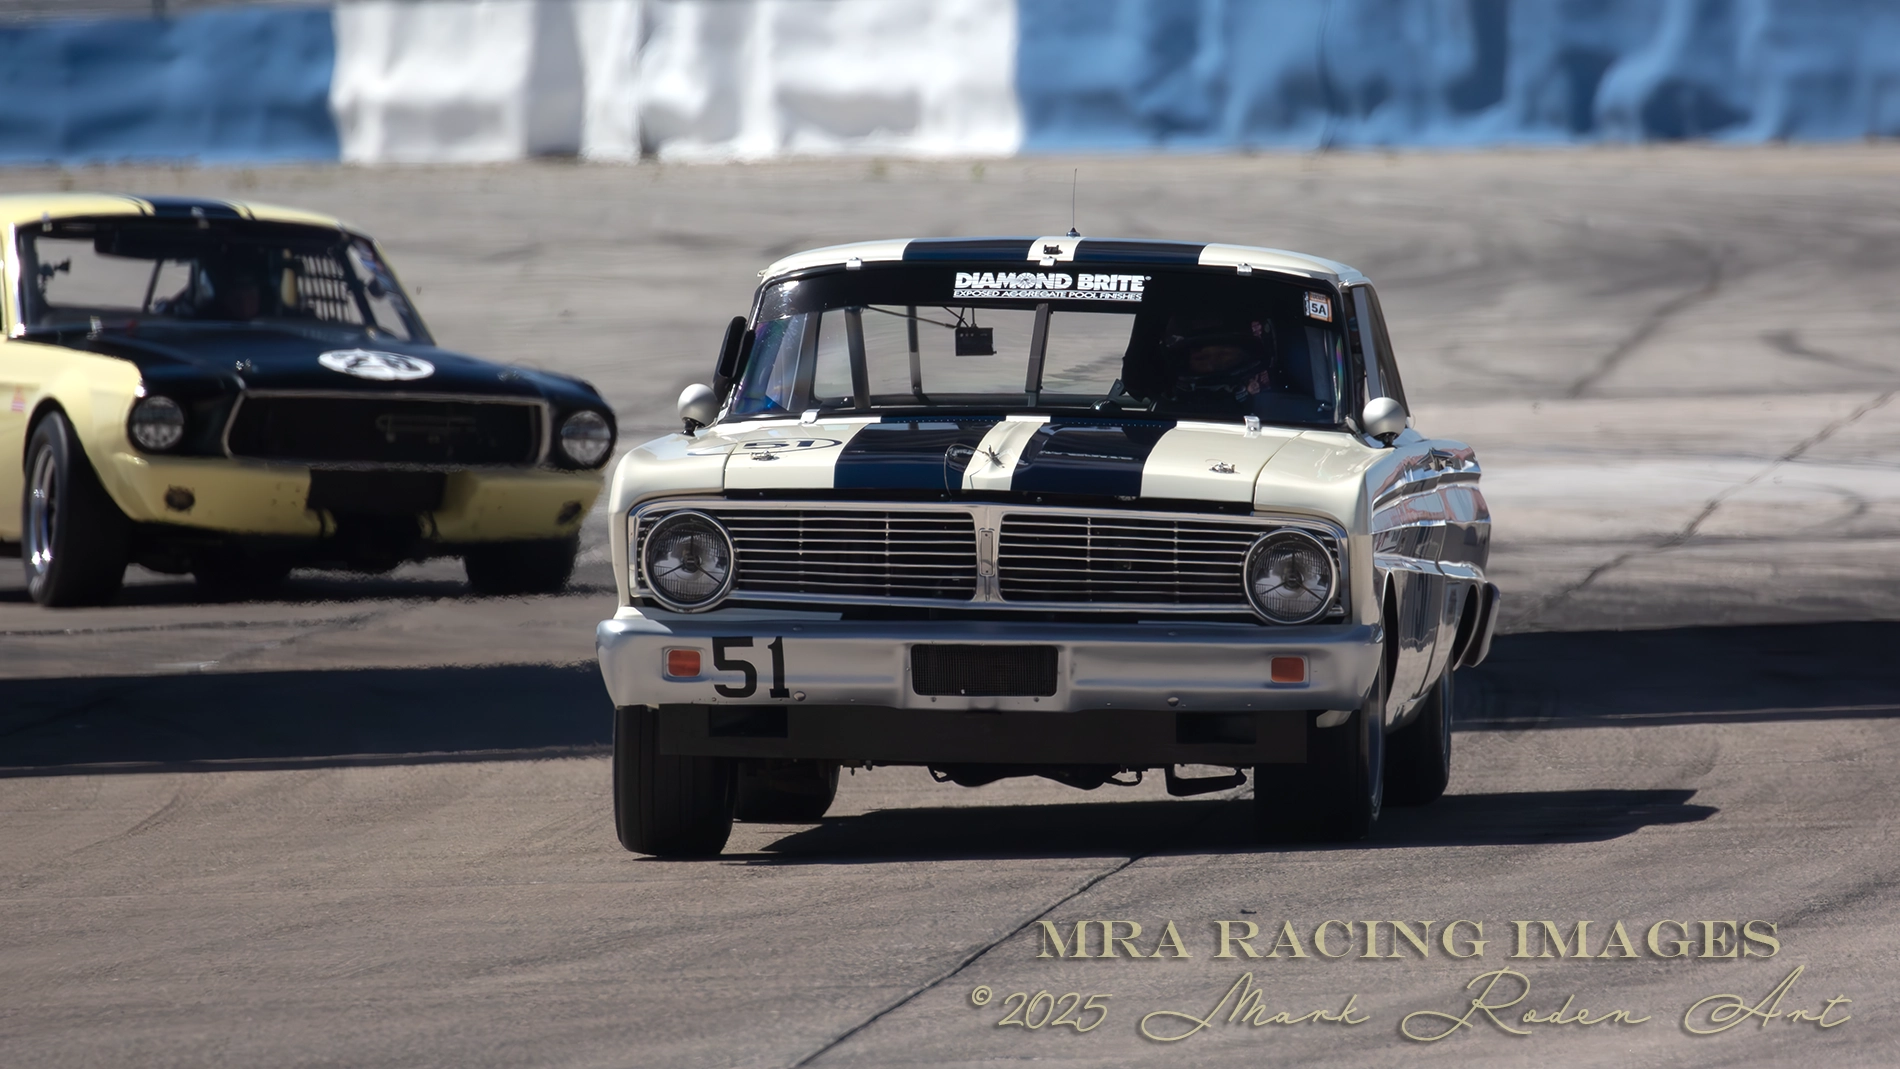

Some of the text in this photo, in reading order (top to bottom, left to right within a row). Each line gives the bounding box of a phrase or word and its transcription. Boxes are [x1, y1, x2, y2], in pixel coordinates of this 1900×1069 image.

[954, 271, 1073, 290] DIAMOND
[953, 289, 1142, 301] EXPOSED AGGREGATE POOL FINISHES
[1311, 302, 1327, 316] 5A
[742, 439, 816, 450] 51
[712, 635, 791, 699] 51
